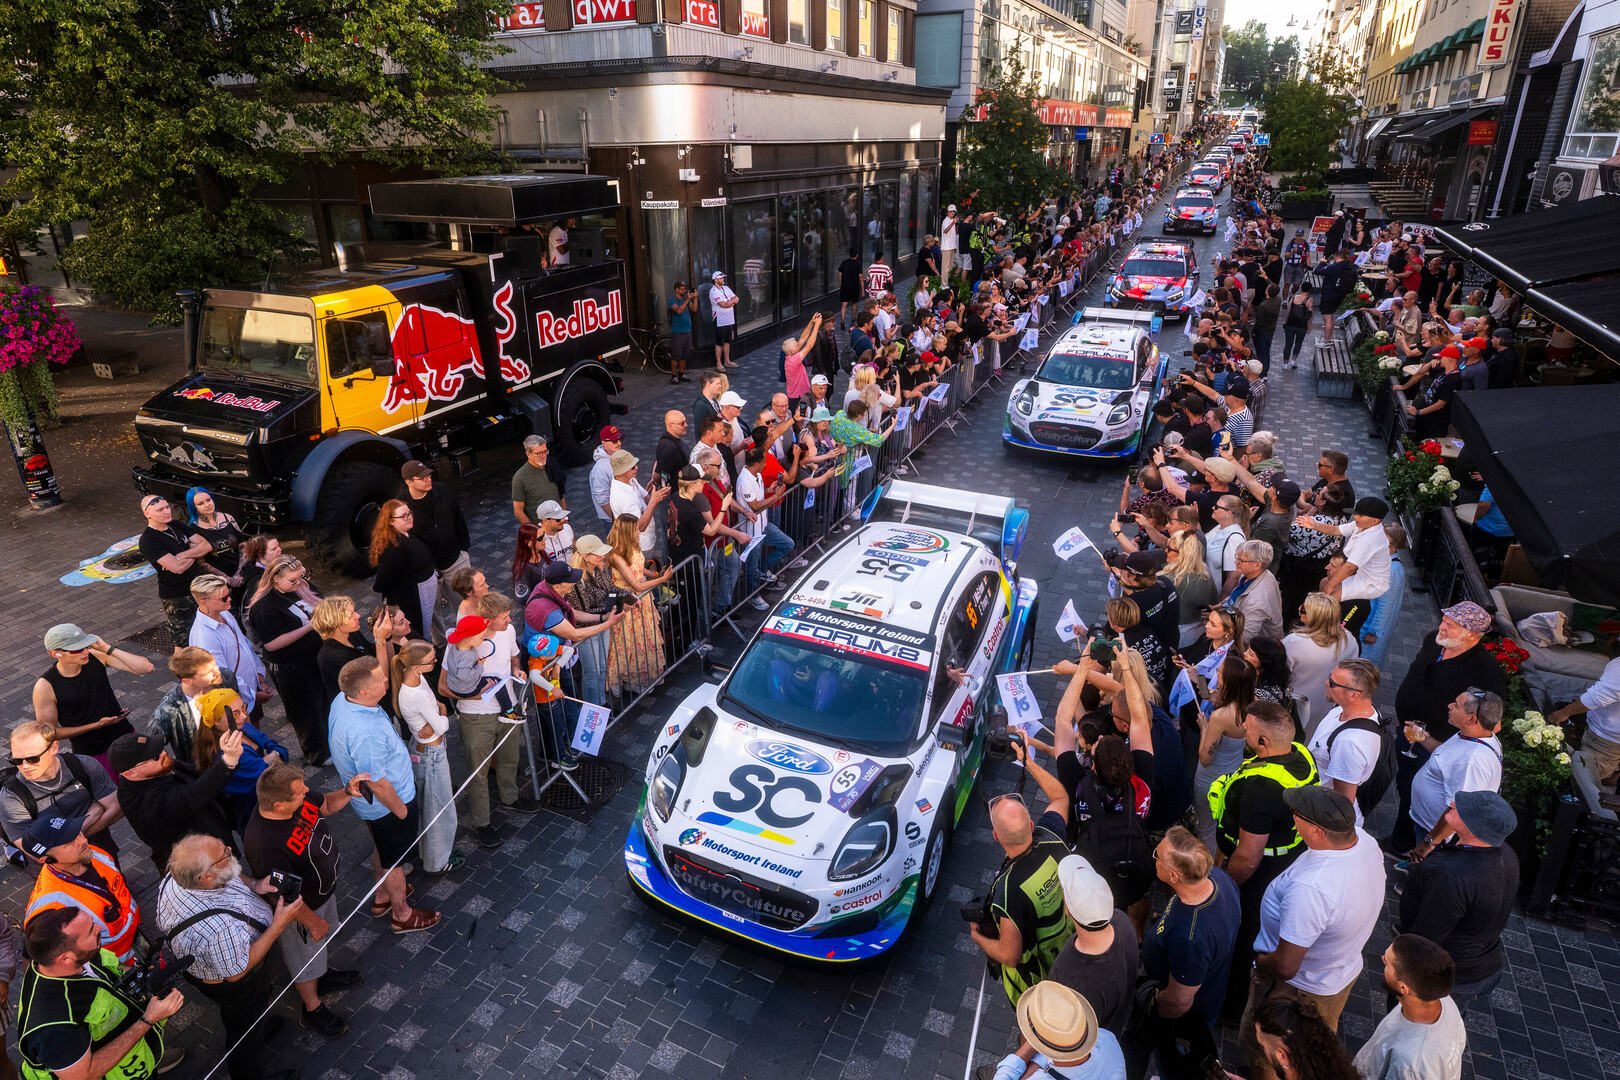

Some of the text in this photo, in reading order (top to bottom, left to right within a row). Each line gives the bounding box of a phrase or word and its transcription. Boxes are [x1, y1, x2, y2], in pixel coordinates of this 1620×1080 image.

[1050, 394, 1098, 409] SC
[856, 559, 915, 582] 55
[807, 612, 926, 645] Motorsport Ireland
[966, 601, 978, 630] 55
[794, 624, 920, 662] FORUM8
[987, 617, 1004, 652] Castrol
[757, 742, 819, 771] Ford
[916, 742, 936, 778] SafetyCulture
[713, 764, 822, 828] SC
[836, 771, 857, 788] 55
[702, 838, 803, 878] Motorsport Ireland
[672, 863, 805, 922] SafetyCulture
[842, 890, 883, 911] Castrol
